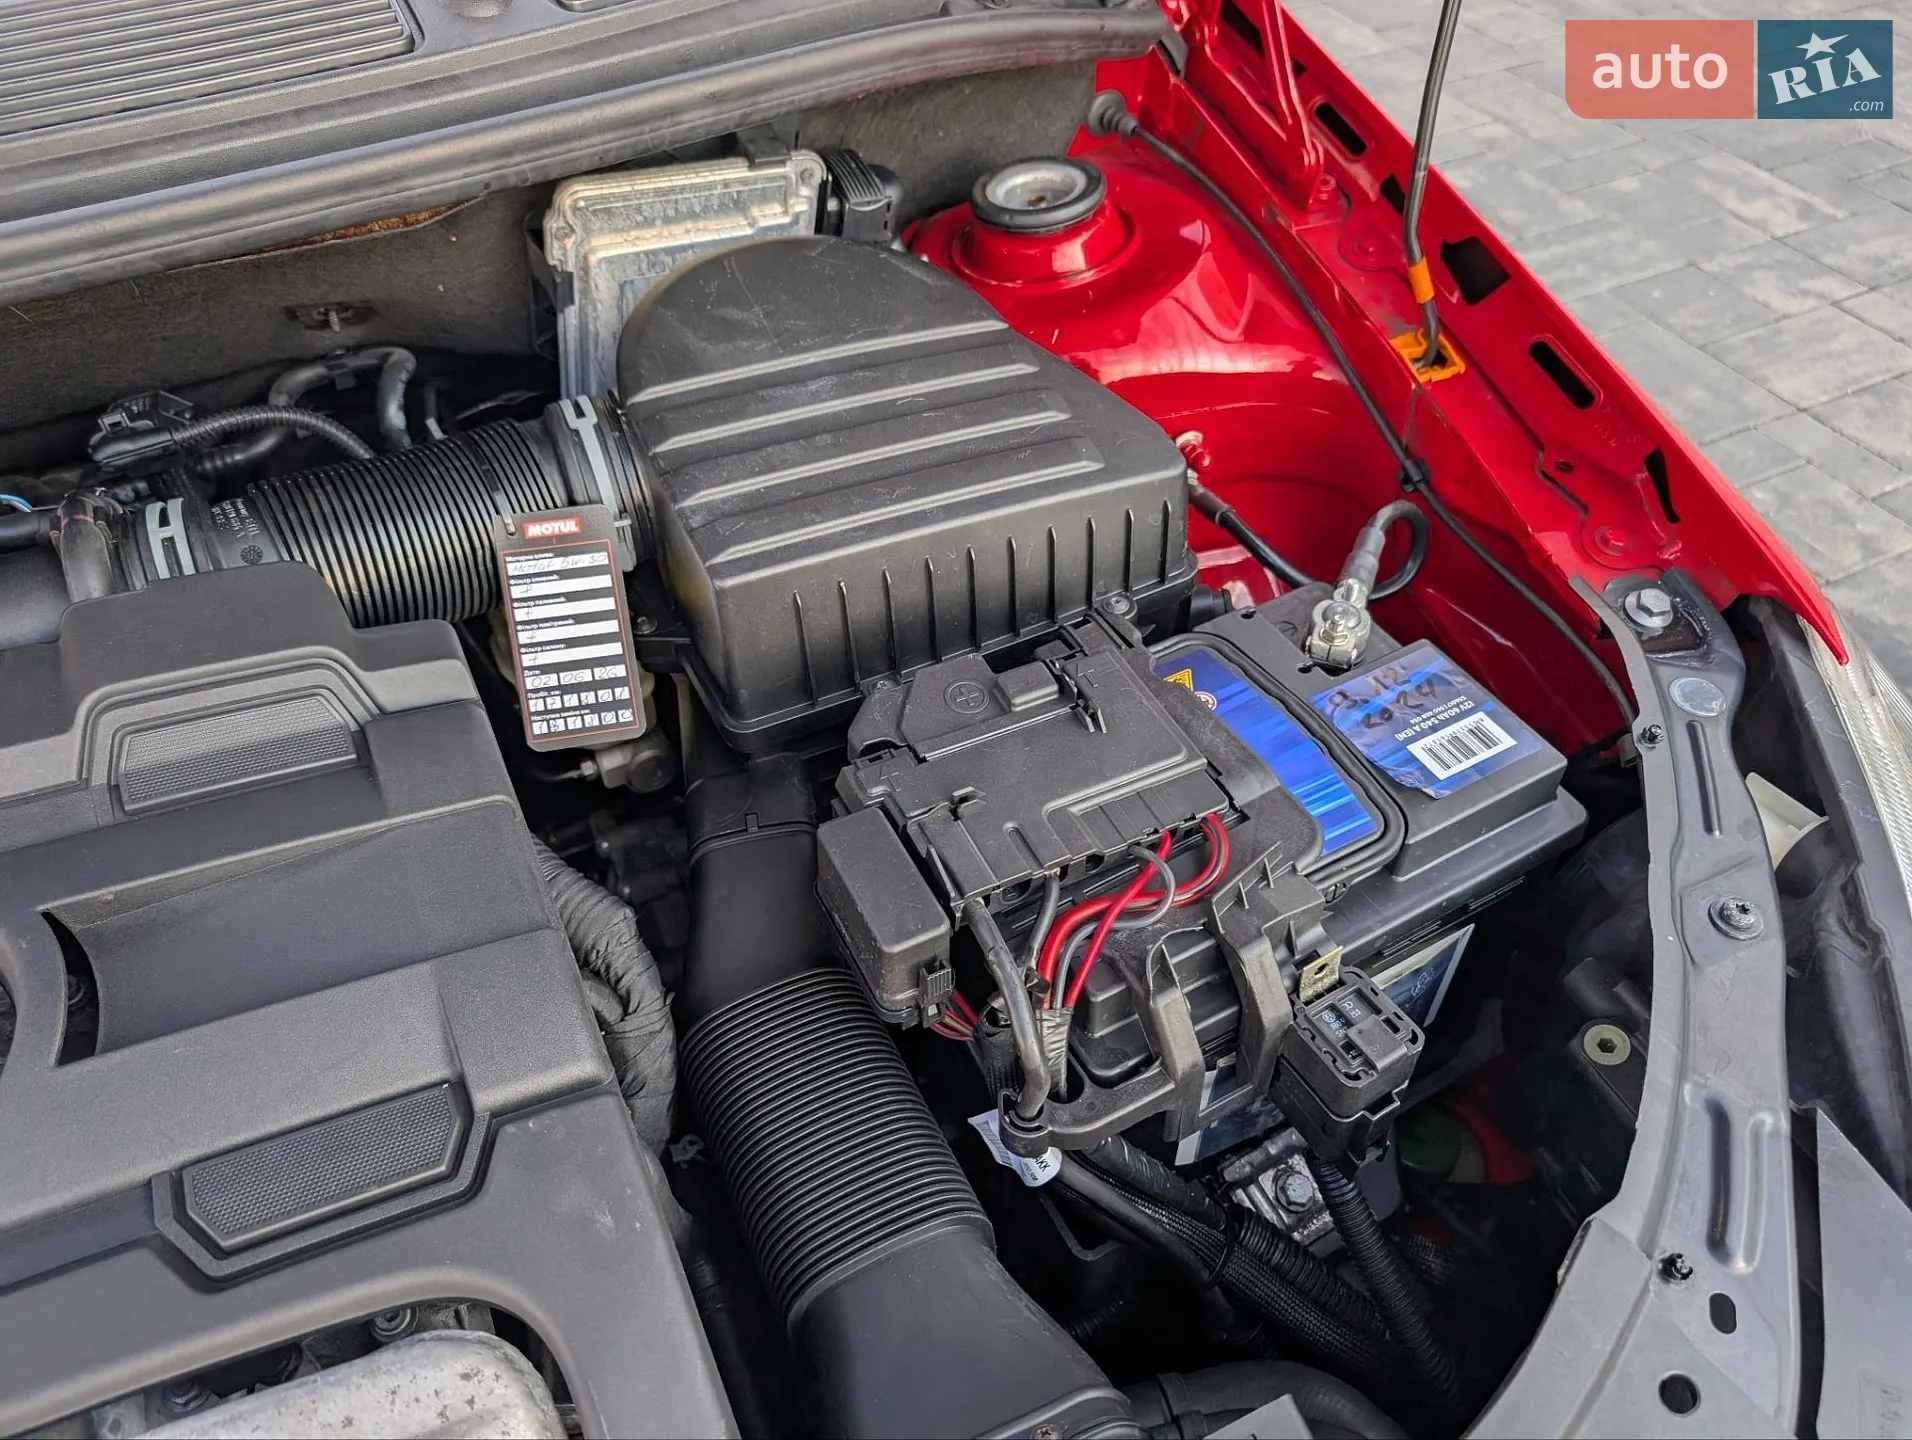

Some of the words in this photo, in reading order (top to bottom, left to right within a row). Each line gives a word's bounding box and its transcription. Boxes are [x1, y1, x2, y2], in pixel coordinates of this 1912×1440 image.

[527, 520, 579, 537] MOTUL
[1460, 700, 1475, 711] 12V
[1437, 707, 1460, 721] 60Ah
[1420, 717, 1438, 729] 540
[1394, 728, 1416, 742] (EN)
